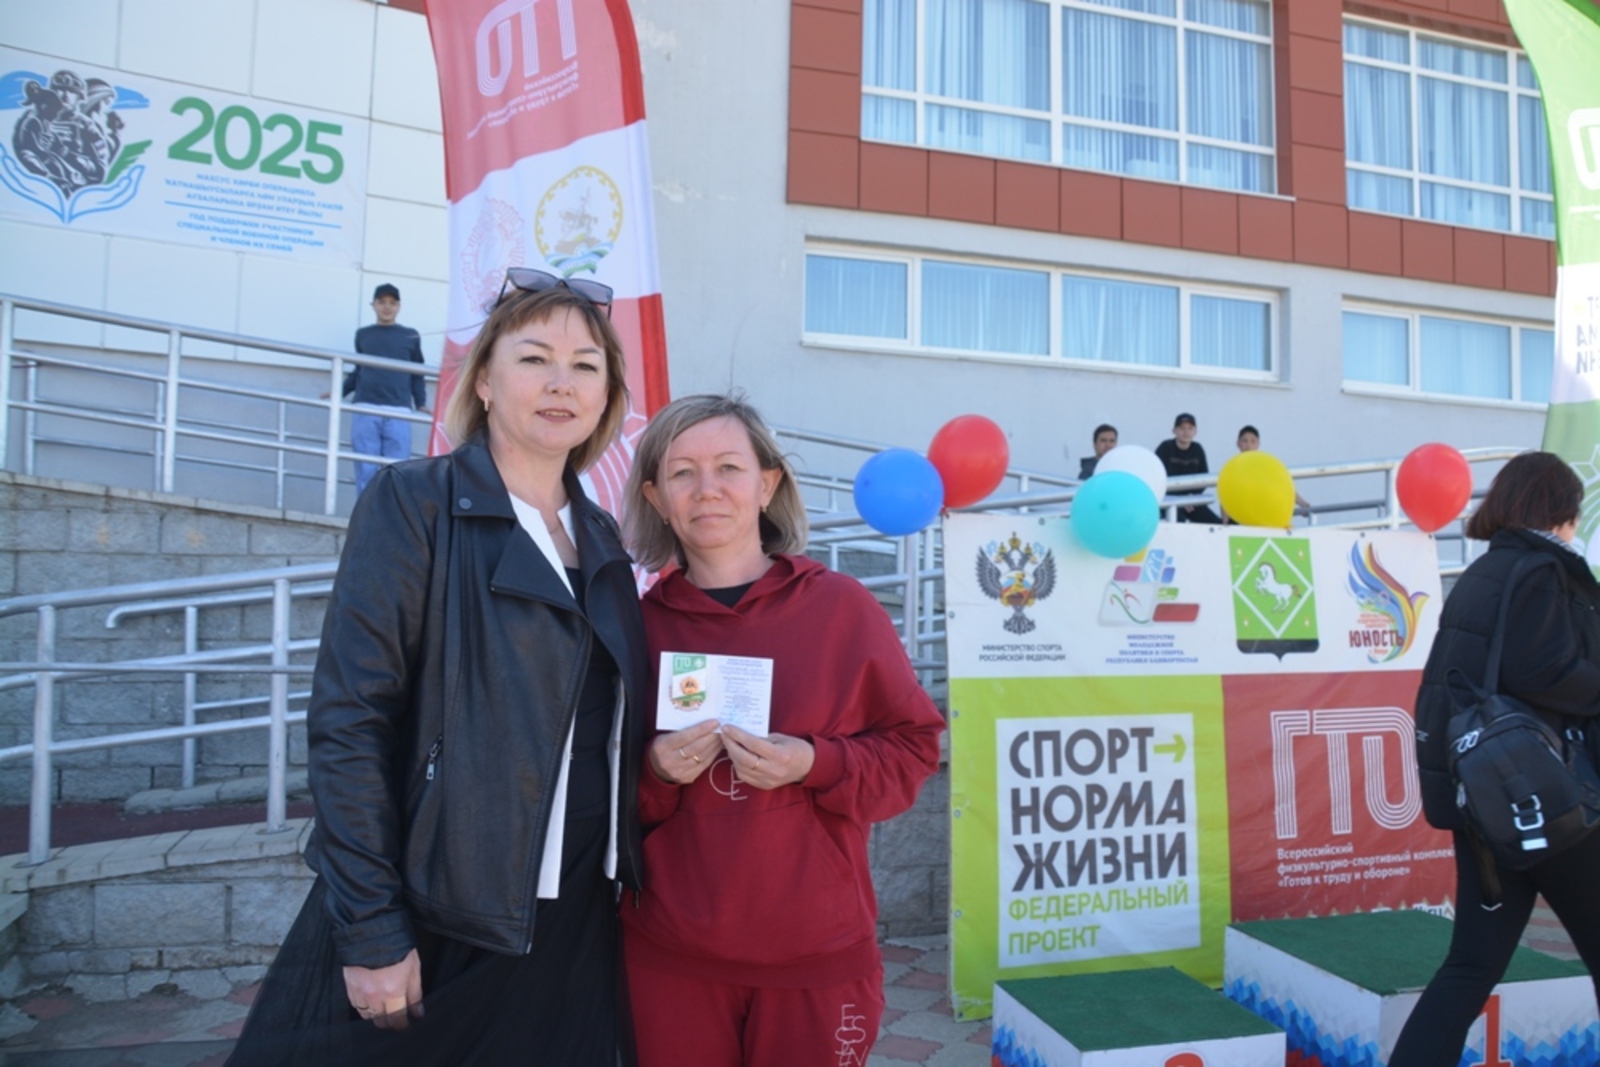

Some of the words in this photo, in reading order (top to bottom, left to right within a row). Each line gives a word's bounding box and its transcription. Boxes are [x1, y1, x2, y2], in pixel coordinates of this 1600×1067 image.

[168, 97, 344, 184] 2025
[982, 644, 1036, 652] МИНИСТЕРСТВО
[1036, 644, 1063, 652] СПОРТА
[1349, 629, 1405, 648] ЮНОСТЬ
[979, 653, 1024, 661] РОССИЙСКОЙ
[1025, 654, 1066, 662] ФЕДЕРАЦИИ
[1008, 727, 1155, 779] СПОРТ
[1270, 707, 1422, 839] ГТО
[1010, 779, 1187, 836] НОРМА
[1011, 832, 1188, 892] ЖИЗНИ
[1277, 843, 1354, 860] Всероссийский
[1277, 850, 1411, 876] физкультурно-спортивный
[1413, 848, 1456, 861] комплек
[1278, 874, 1313, 888] «Готов
[1314, 876, 1321, 884] к
[1323, 872, 1352, 885] труду
[1354, 871, 1361, 880] и
[1363, 866, 1411, 879] обороне»
[1008, 879, 1189, 923] ФЕДЕРАЛЬНЫЙ
[1008, 924, 1101, 955] ПРОЕКТ
[1471, 994, 1513, 1067] 1
